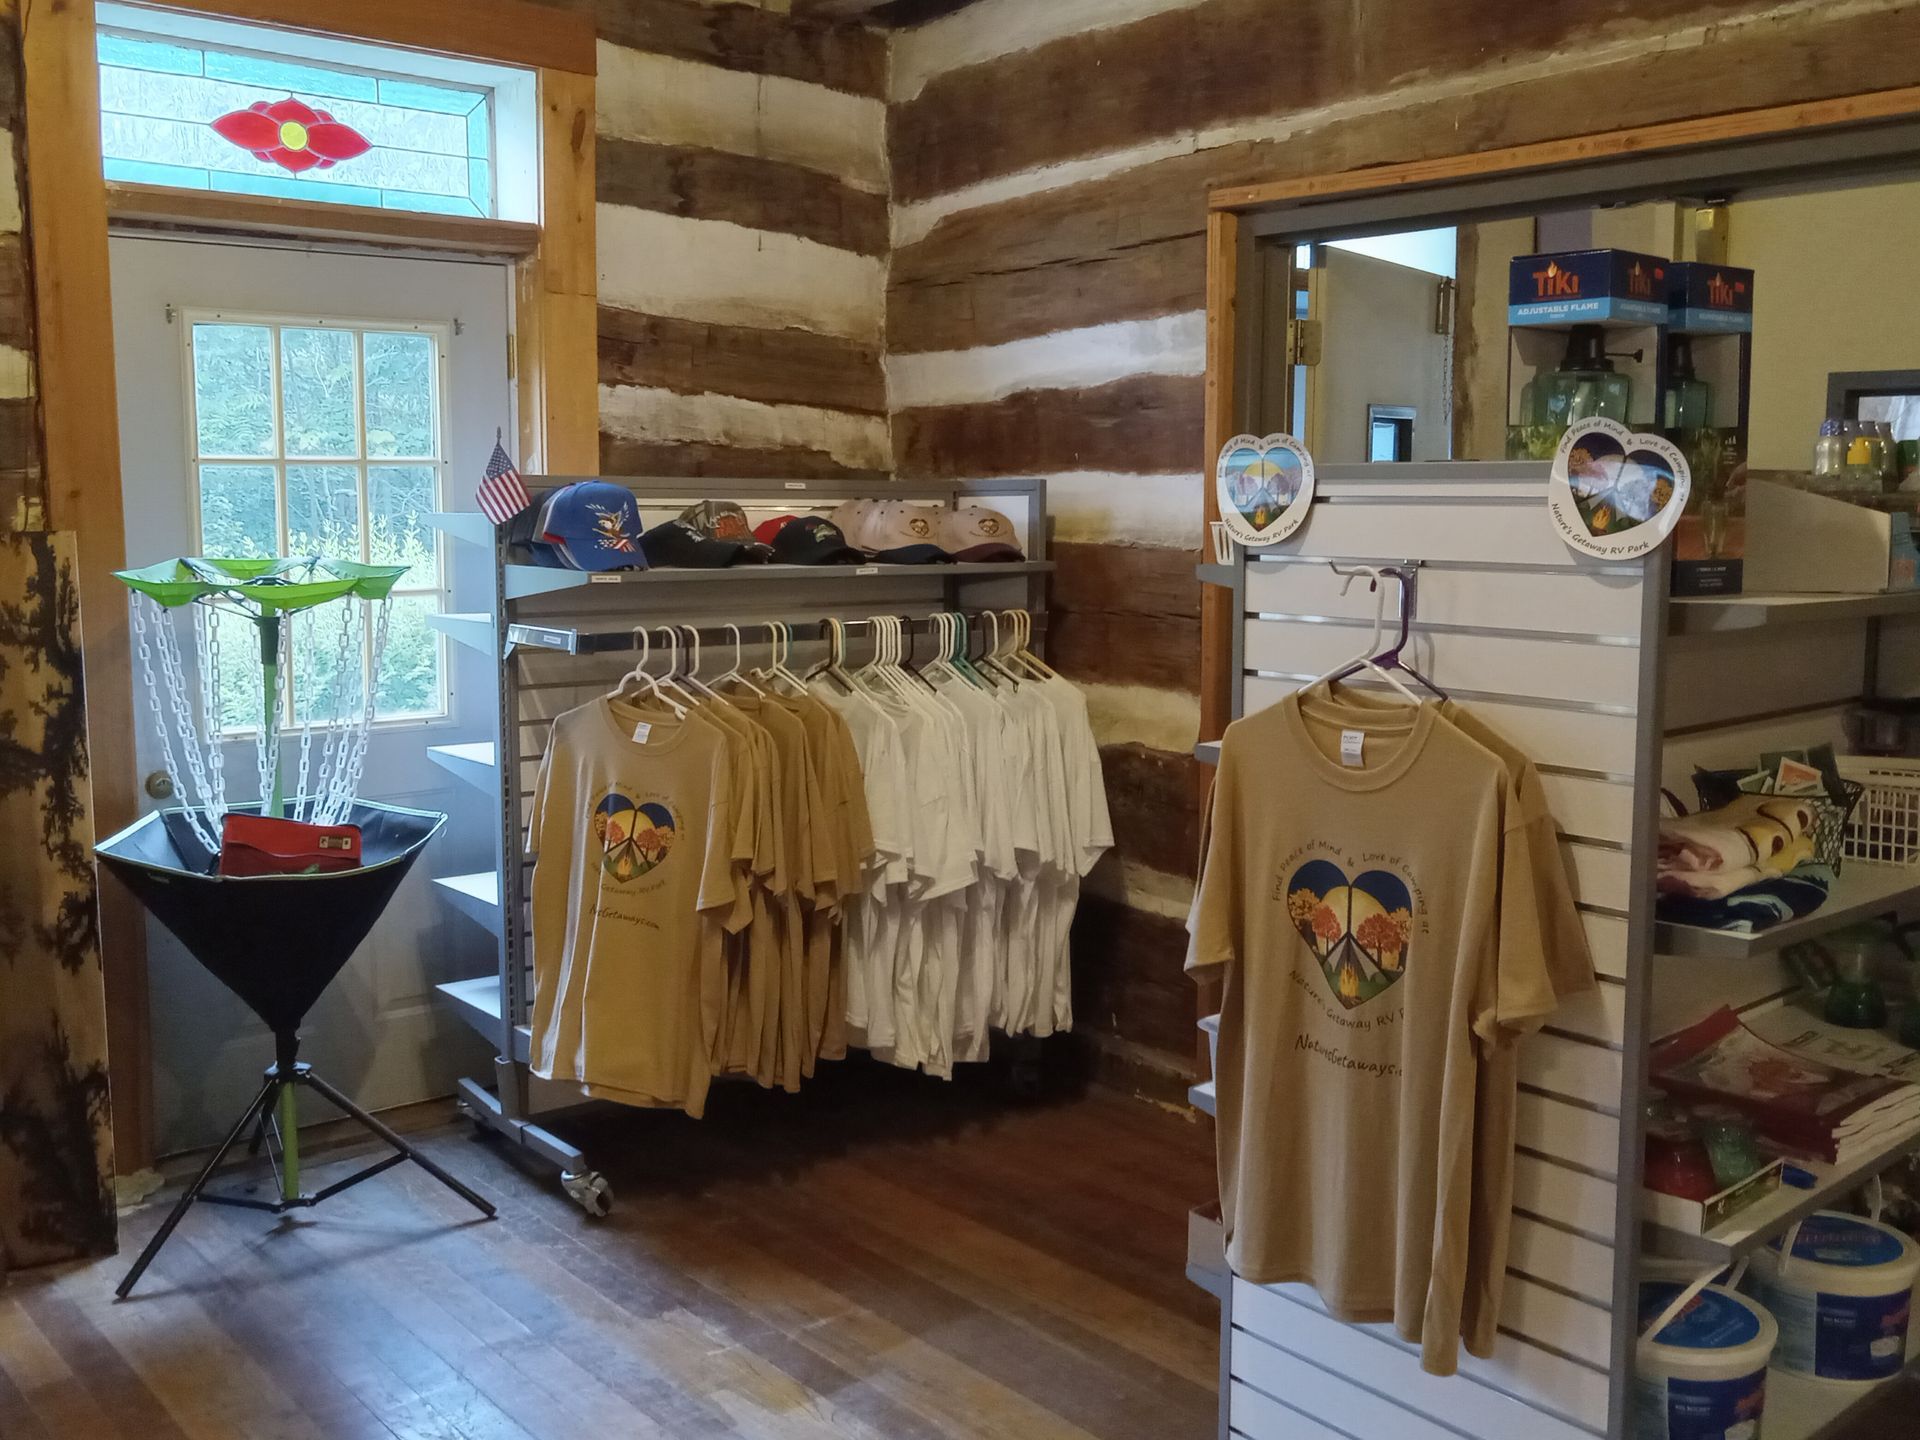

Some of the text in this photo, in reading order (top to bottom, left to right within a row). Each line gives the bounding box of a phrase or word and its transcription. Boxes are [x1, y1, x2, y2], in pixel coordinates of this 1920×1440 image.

[1517, 305, 1569, 316] ADJUSTABLE
[1570, 302, 1599, 312] FLAME
[1267, 438, 1281, 446] Love
[1571, 423, 1592, 436] Peace
[1593, 420, 1602, 428] of
[1604, 422, 1624, 435] Mind
[1626, 438, 1633, 446] &
[1639, 438, 1659, 447] Love
[1661, 443, 1669, 453] of
[1669, 452, 1687, 489] Camping
[1225, 517, 1300, 544] Nature's Getaway RV Park
[1551, 502, 1650, 556] Nature's Getaway RV Park
[1272, 874, 1285, 902] Find
[1280, 846, 1304, 873] Peace
[1306, 839, 1316, 851] of
[1318, 840, 1343, 857] Mind
[1346, 857, 1355, 868] &
[1362, 852, 1386, 863] Love
[1389, 856, 1402, 866] of
[1402, 864, 1429, 916] Camping
[1325, 1008, 1372, 1033] Getaway
[1376, 1011, 1395, 1027] RV
